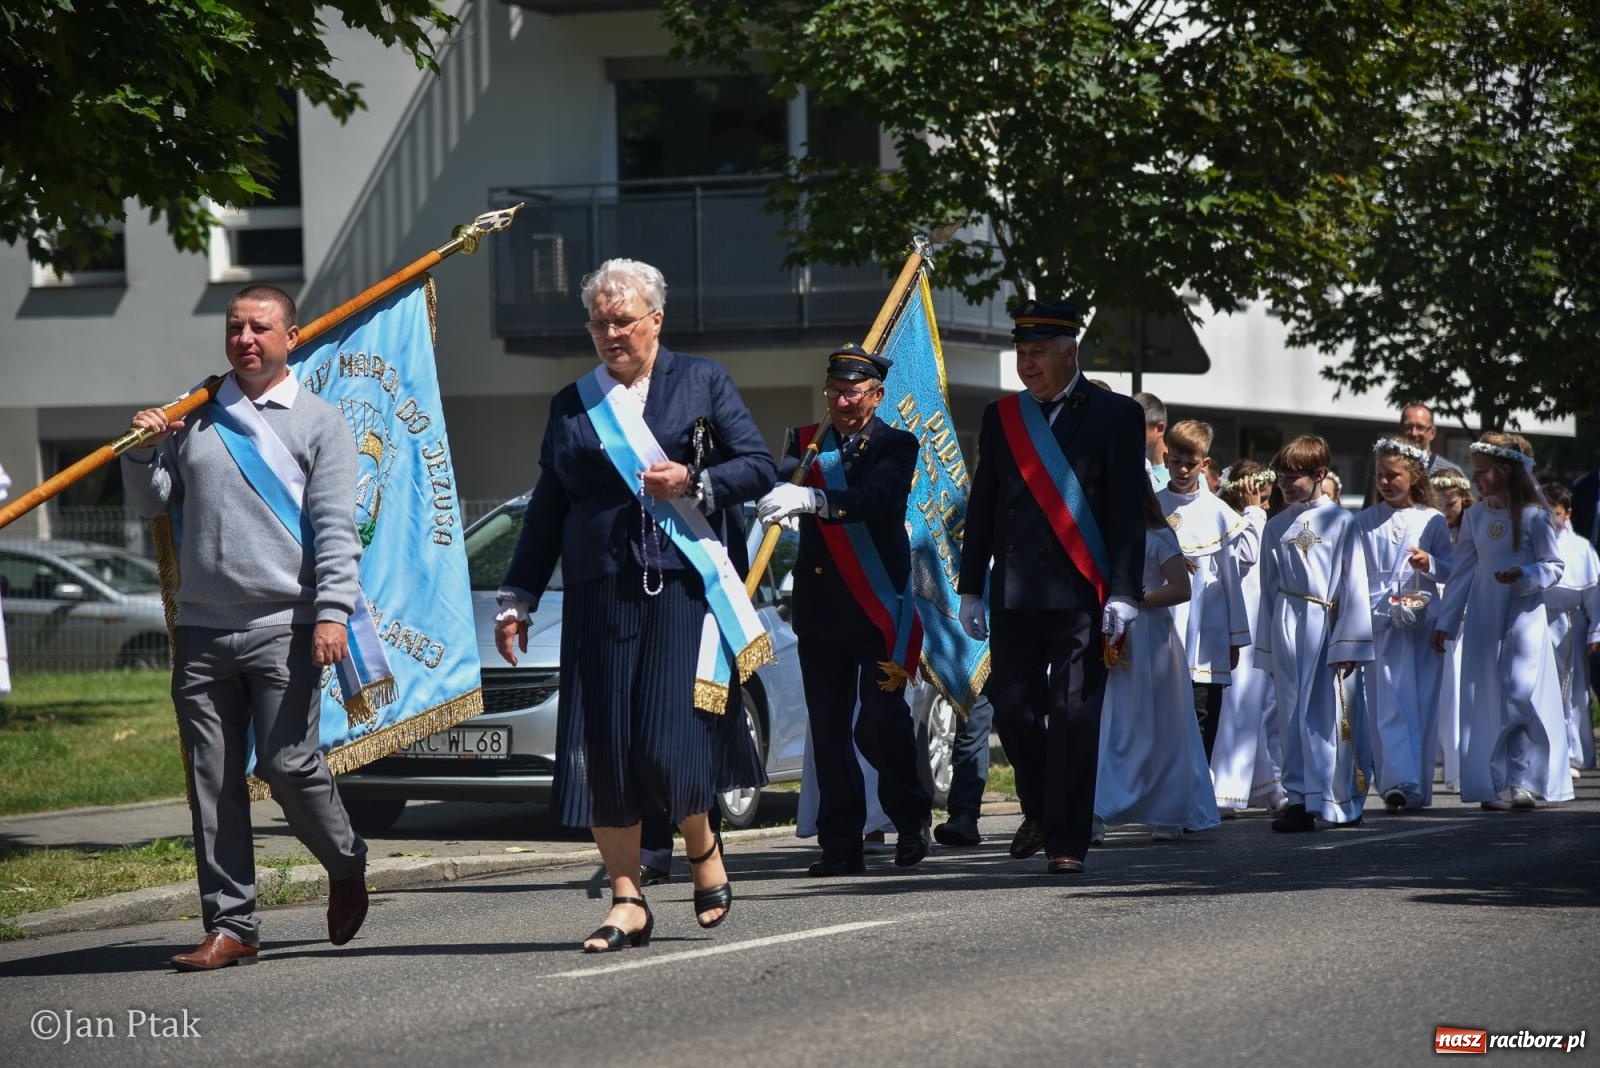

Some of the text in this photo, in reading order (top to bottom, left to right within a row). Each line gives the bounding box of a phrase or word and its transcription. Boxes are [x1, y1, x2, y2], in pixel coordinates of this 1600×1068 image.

[395, 397, 431, 434] DO
[422, 439, 453, 546] JEZUSA
[923, 410, 970, 502] PARAF
[448, 730, 502, 753] WL68
